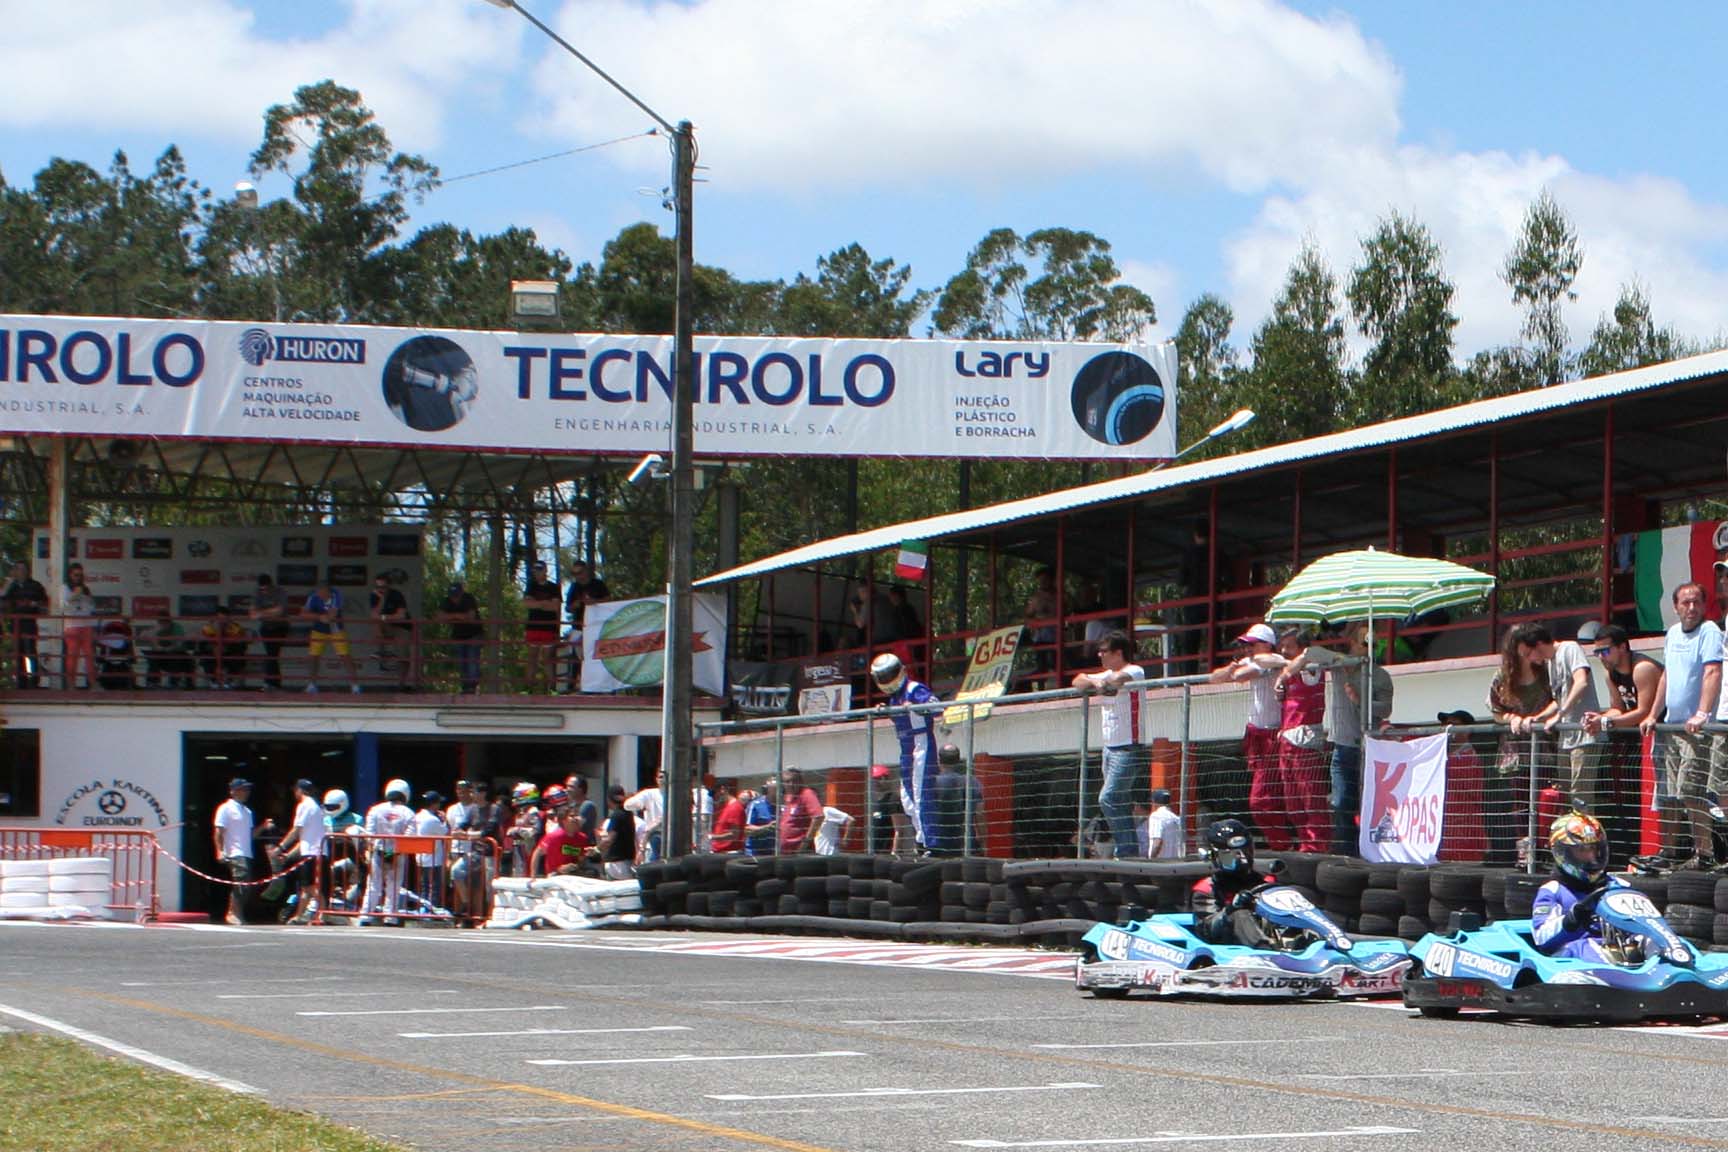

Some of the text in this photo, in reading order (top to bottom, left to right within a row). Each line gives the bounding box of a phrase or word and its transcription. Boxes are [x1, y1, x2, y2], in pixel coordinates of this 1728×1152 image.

[0, 329, 205, 388] IROLO
[284, 340, 358, 361] HURON
[955, 351, 1050, 378] Lary
[243, 376, 303, 389] CENTROS
[503, 346, 896, 408] TECNIROLO
[243, 391, 333, 406] MAQUINAÇÃO
[955, 395, 1010, 409] INJEÇÃO
[243, 407, 361, 422] ALTA VELOCIDADE
[955, 410, 1016, 423] PLÁSTICO
[554, 417, 843, 437] ENGENHARIA NDUSTRIAL, S.A.
[955, 426, 1036, 438] E BORRACHA
[975, 631, 1019, 666] GAS
[113, 779, 169, 827] KARTING
[1457, 950, 1512, 978] TECNIROLO
